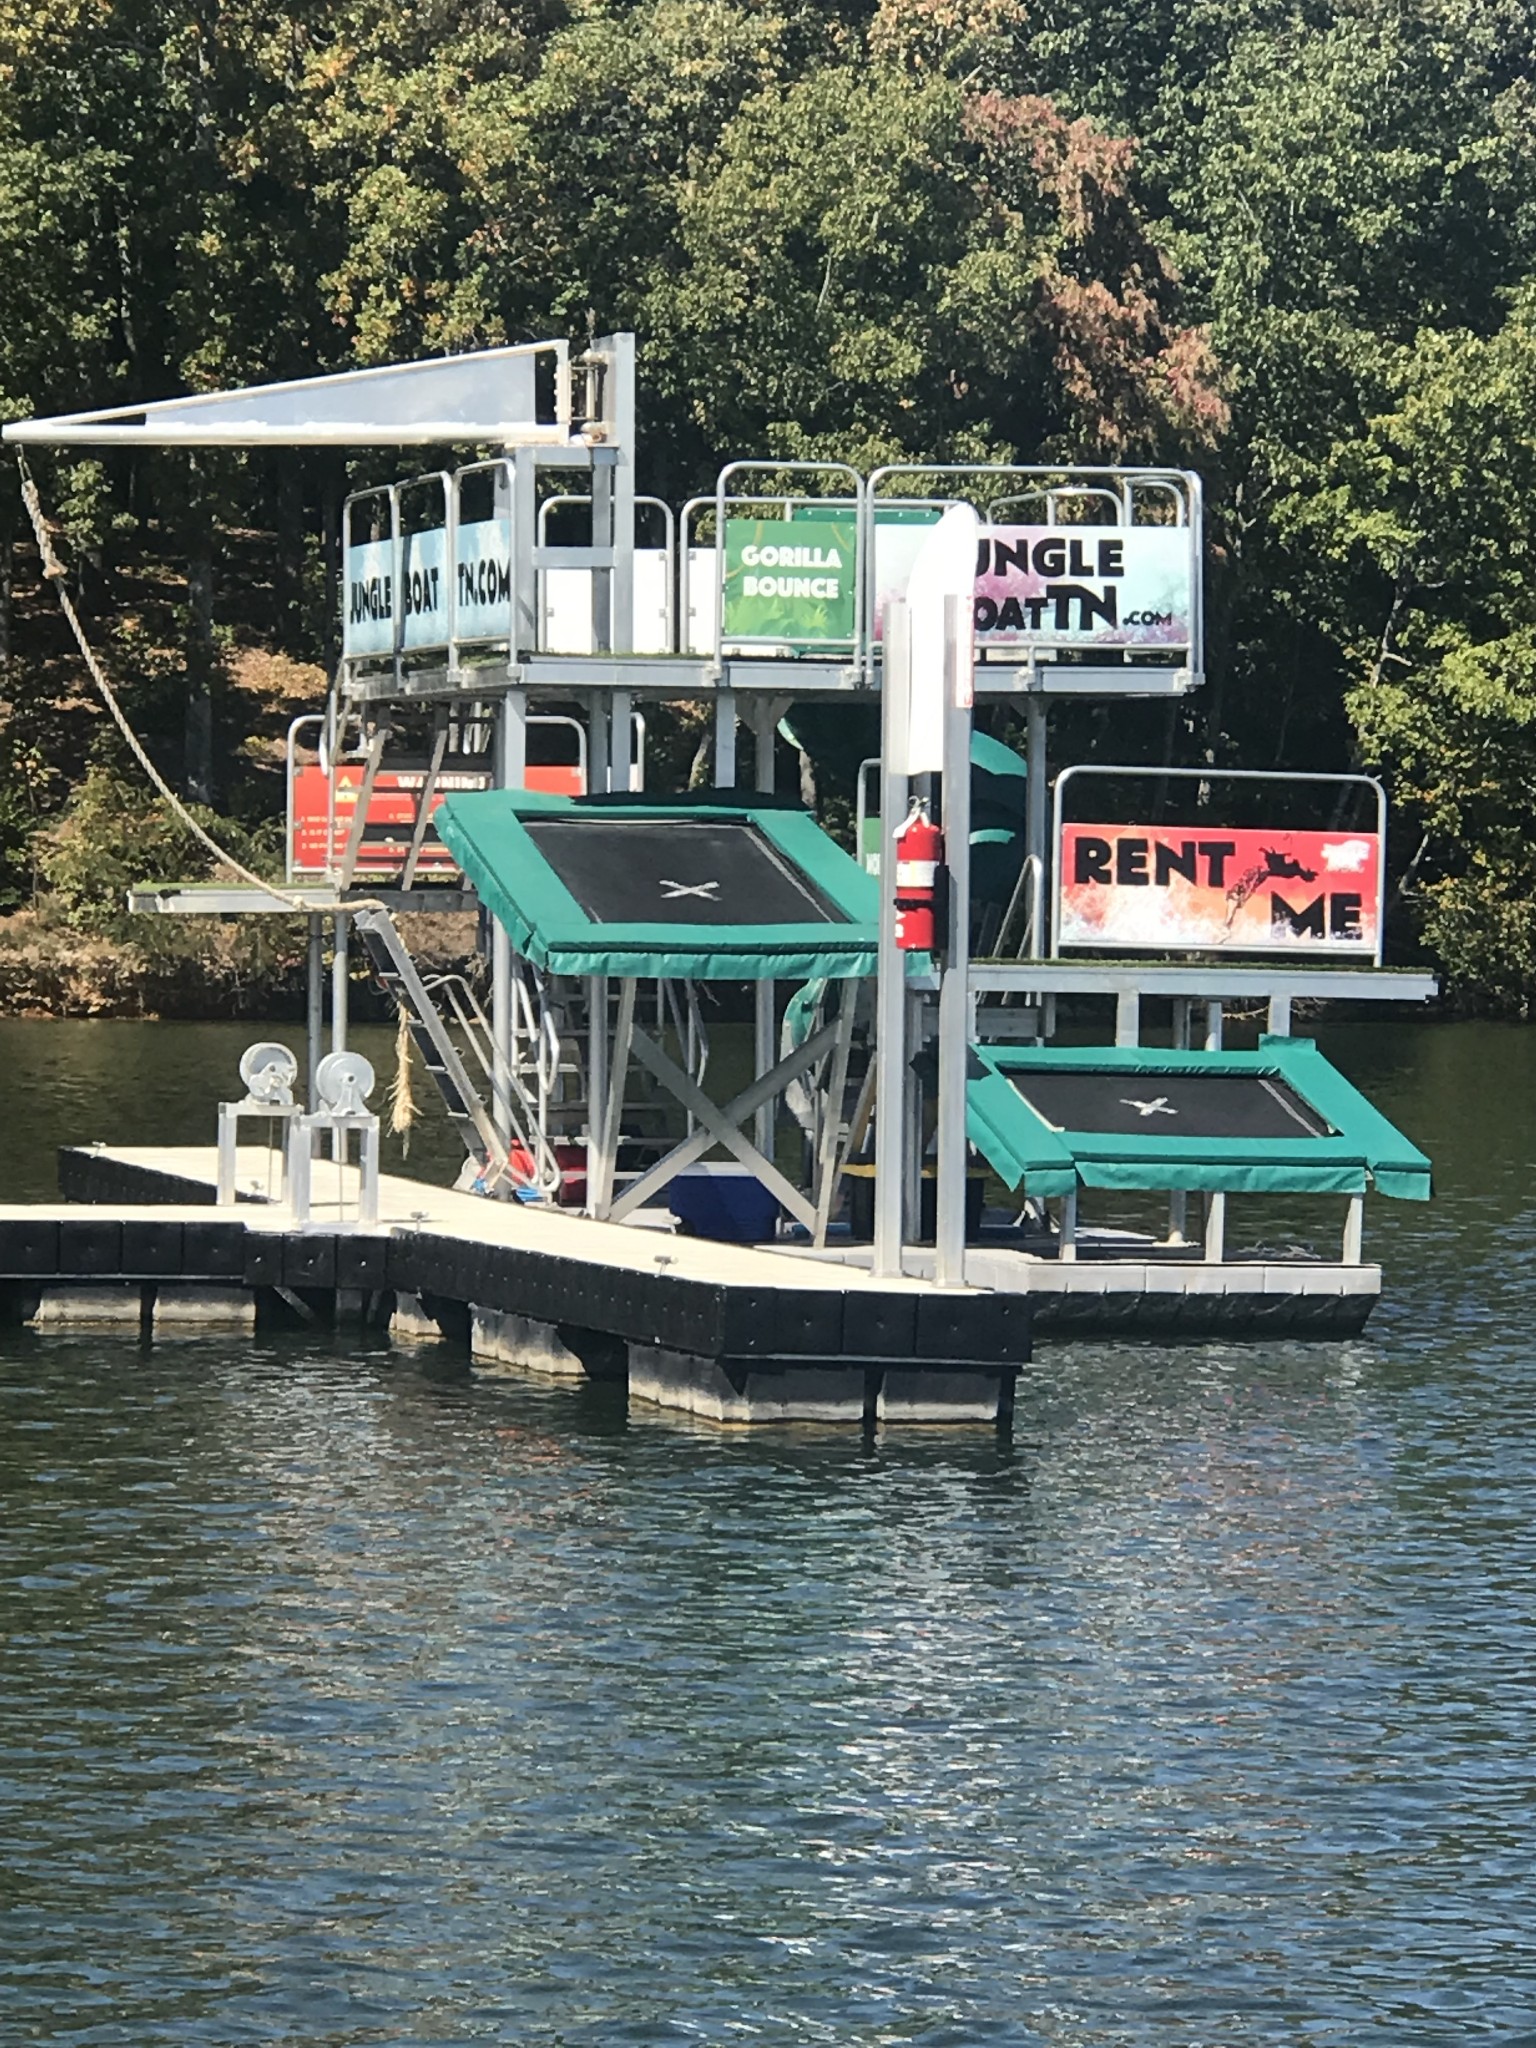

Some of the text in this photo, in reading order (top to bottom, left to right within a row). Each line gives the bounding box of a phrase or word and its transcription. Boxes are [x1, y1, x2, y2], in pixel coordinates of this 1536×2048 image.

[741, 545, 843, 569] GORILLA
[975, 537, 1125, 577] UNGLE
[350, 575, 392, 624] JUNGLE
[405, 566, 439, 616] BOAT
[743, 575, 839, 599] BOUNCE
[1074, 836, 1236, 888] RENT
[1270, 890, 1363, 941] ME
